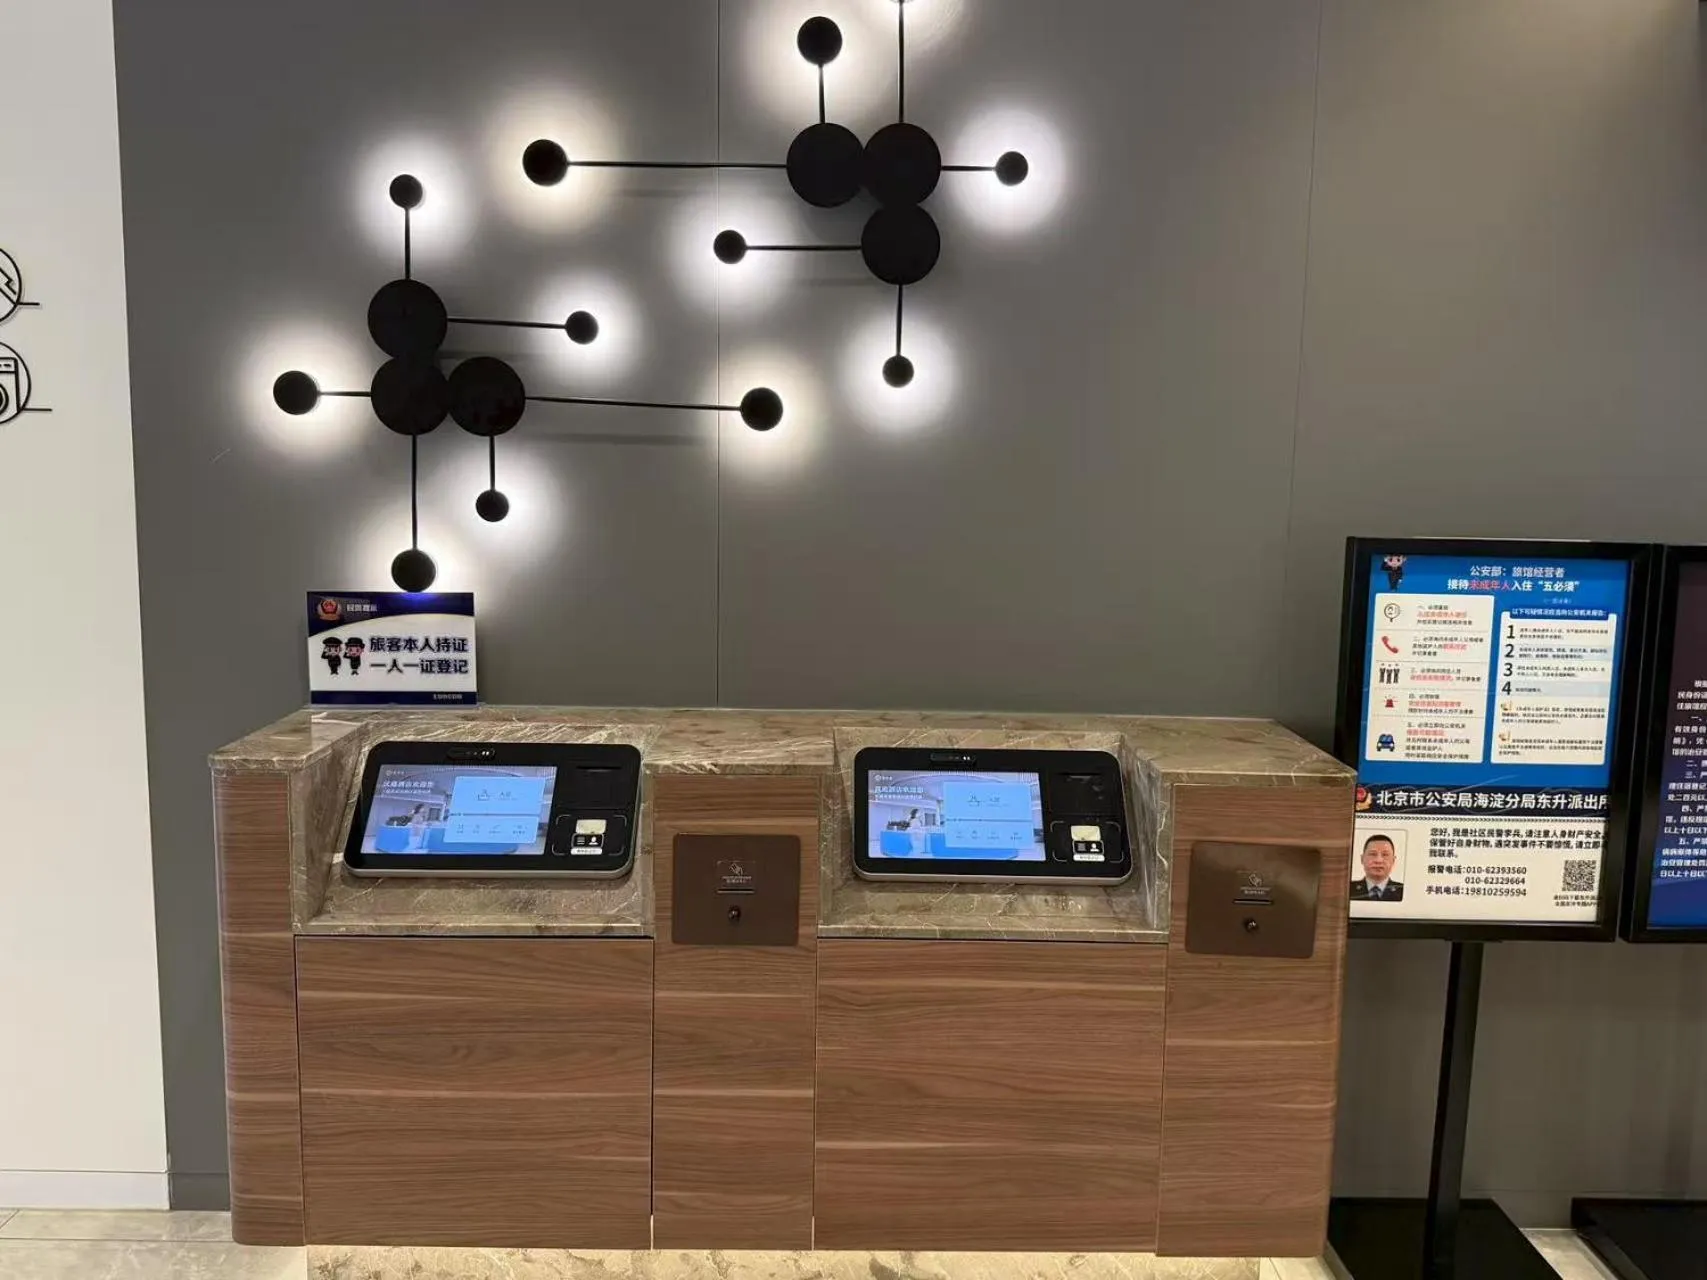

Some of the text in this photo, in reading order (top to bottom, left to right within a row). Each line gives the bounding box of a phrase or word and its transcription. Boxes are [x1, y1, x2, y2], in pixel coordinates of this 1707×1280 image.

[1506, 624, 1515, 639] 1
[369, 636, 469, 653] 旅客本人持证
[1504, 643, 1515, 658] 2
[369, 658, 469, 675] 一人一证登记
[1503, 663, 1513, 677] 3
[1501, 681, 1512, 695] 4
